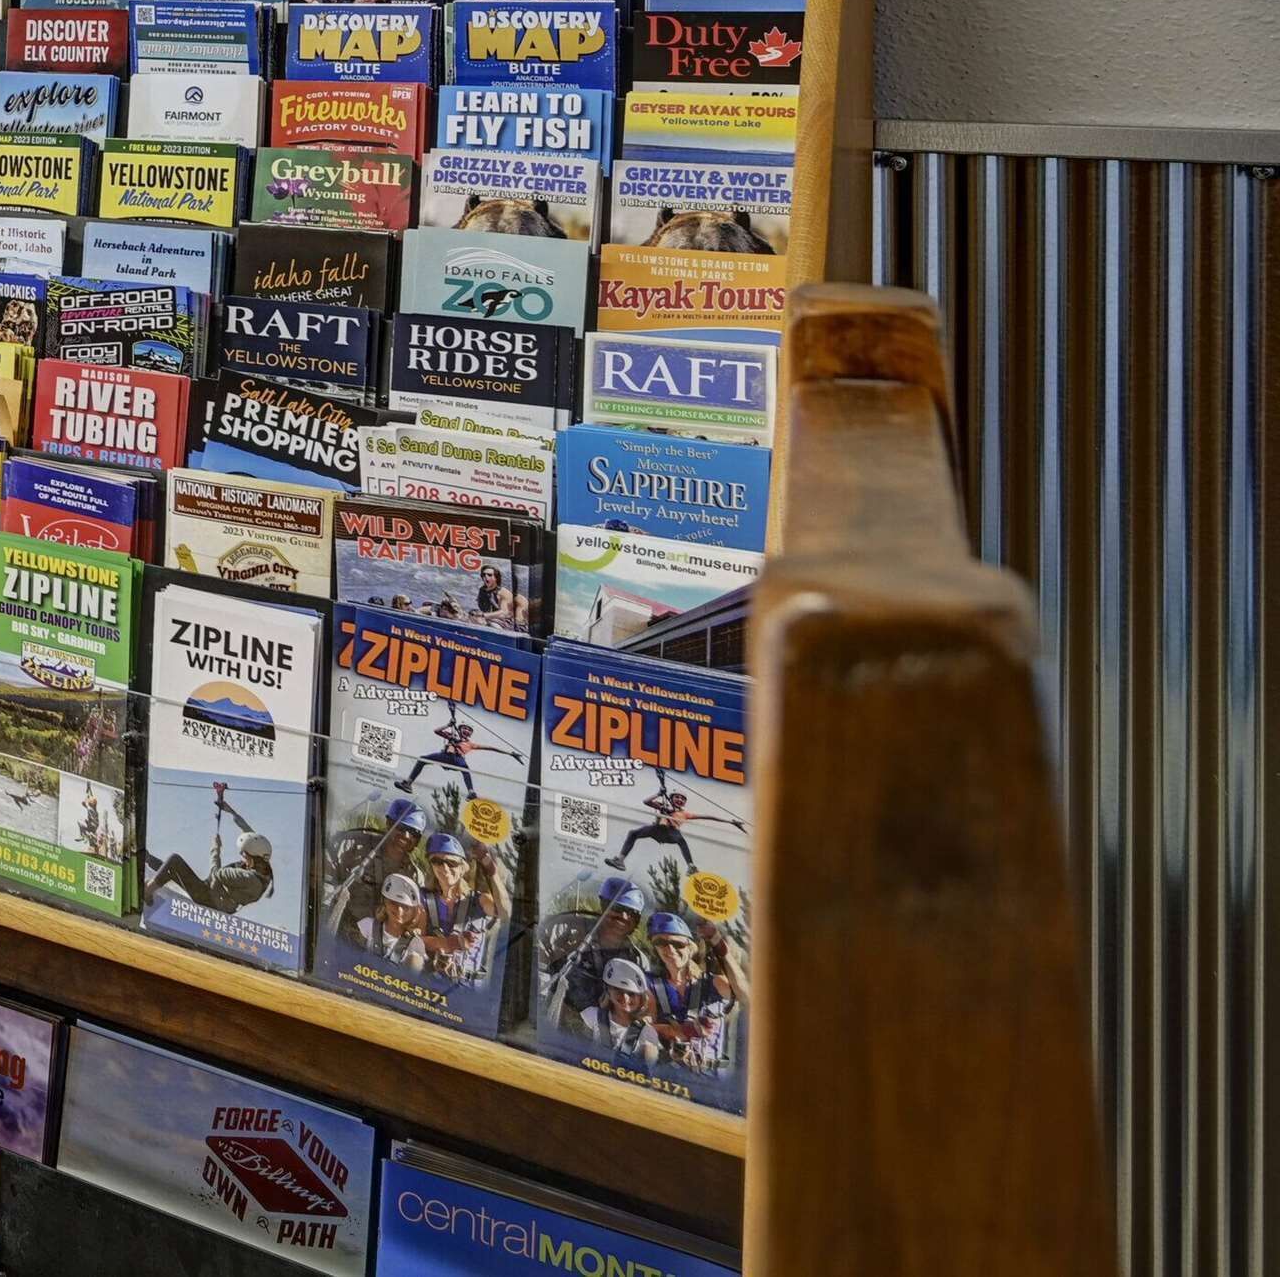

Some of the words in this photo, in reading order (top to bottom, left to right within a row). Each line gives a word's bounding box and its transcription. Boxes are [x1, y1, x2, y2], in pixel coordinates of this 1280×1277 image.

[645, 15, 748, 50] Duty
[334, 63, 381, 74] BUTTE
[666, 46, 752, 78] Free
[164, 111, 222, 122] FAIRMONT
[279, 93, 408, 133] Fireworks
[455, 91, 539, 115] LEARN
[546, 92, 583, 116] TO
[630, 103, 686, 116] GEYSER
[689, 104, 742, 117] KAYAK
[744, 105, 796, 119] TOURS
[446, 115, 507, 147] FLY
[515, 117, 591, 150] FISH
[109, 162, 229, 192] YELLOWSTONE
[271, 158, 402, 187] Greybull
[619, 181, 719, 200] DISCOVERY
[721, 185, 791, 204] CENTER
[625, 167, 705, 185] GRIZZLY
[707, 169, 724, 186] &
[728, 172, 787, 189] WOLF
[118, 188, 175, 208] National
[177, 193, 214, 213] Park
[254, 259, 312, 291] idaho
[319, 252, 370, 294] falls
[444, 265, 496, 279] IDAHO
[501, 271, 554, 286] FALLS
[599, 280, 695, 317] Kayak
[699, 281, 785, 310] Tours
[225, 305, 360, 346] RAFT
[409, 325, 538, 356] HORSE
[407, 348, 538, 381] RIDES
[600, 349, 763, 403] RAFT
[54, 376, 157, 419] RIVER
[49, 409, 158, 453] TUBING
[219, 414, 357, 472] SHOPPING
[587, 454, 749, 512] SAPPHIRE
[341, 510, 412, 541] WILD
[422, 520, 501, 551] WEST
[3, 546, 119, 588] YELLOWSTONE
[358, 538, 483, 572] RAFTING
[2, 566, 118, 624] ZIPLINE
[169, 618, 294, 671] ZIPLINE
[186, 648, 241, 679] WITH
[247, 662, 283, 690] US!
[550, 695, 747, 784] ZIPLINE
[581, 1055, 692, 1101] 406-646-5171
[211, 1105, 282, 1134] FORGE
[297, 1123, 350, 1189] YOUR
[224, 1140, 336, 1217] Billings
[202, 1154, 249, 1224] OWN
[275, 1219, 337, 1249] PATH
